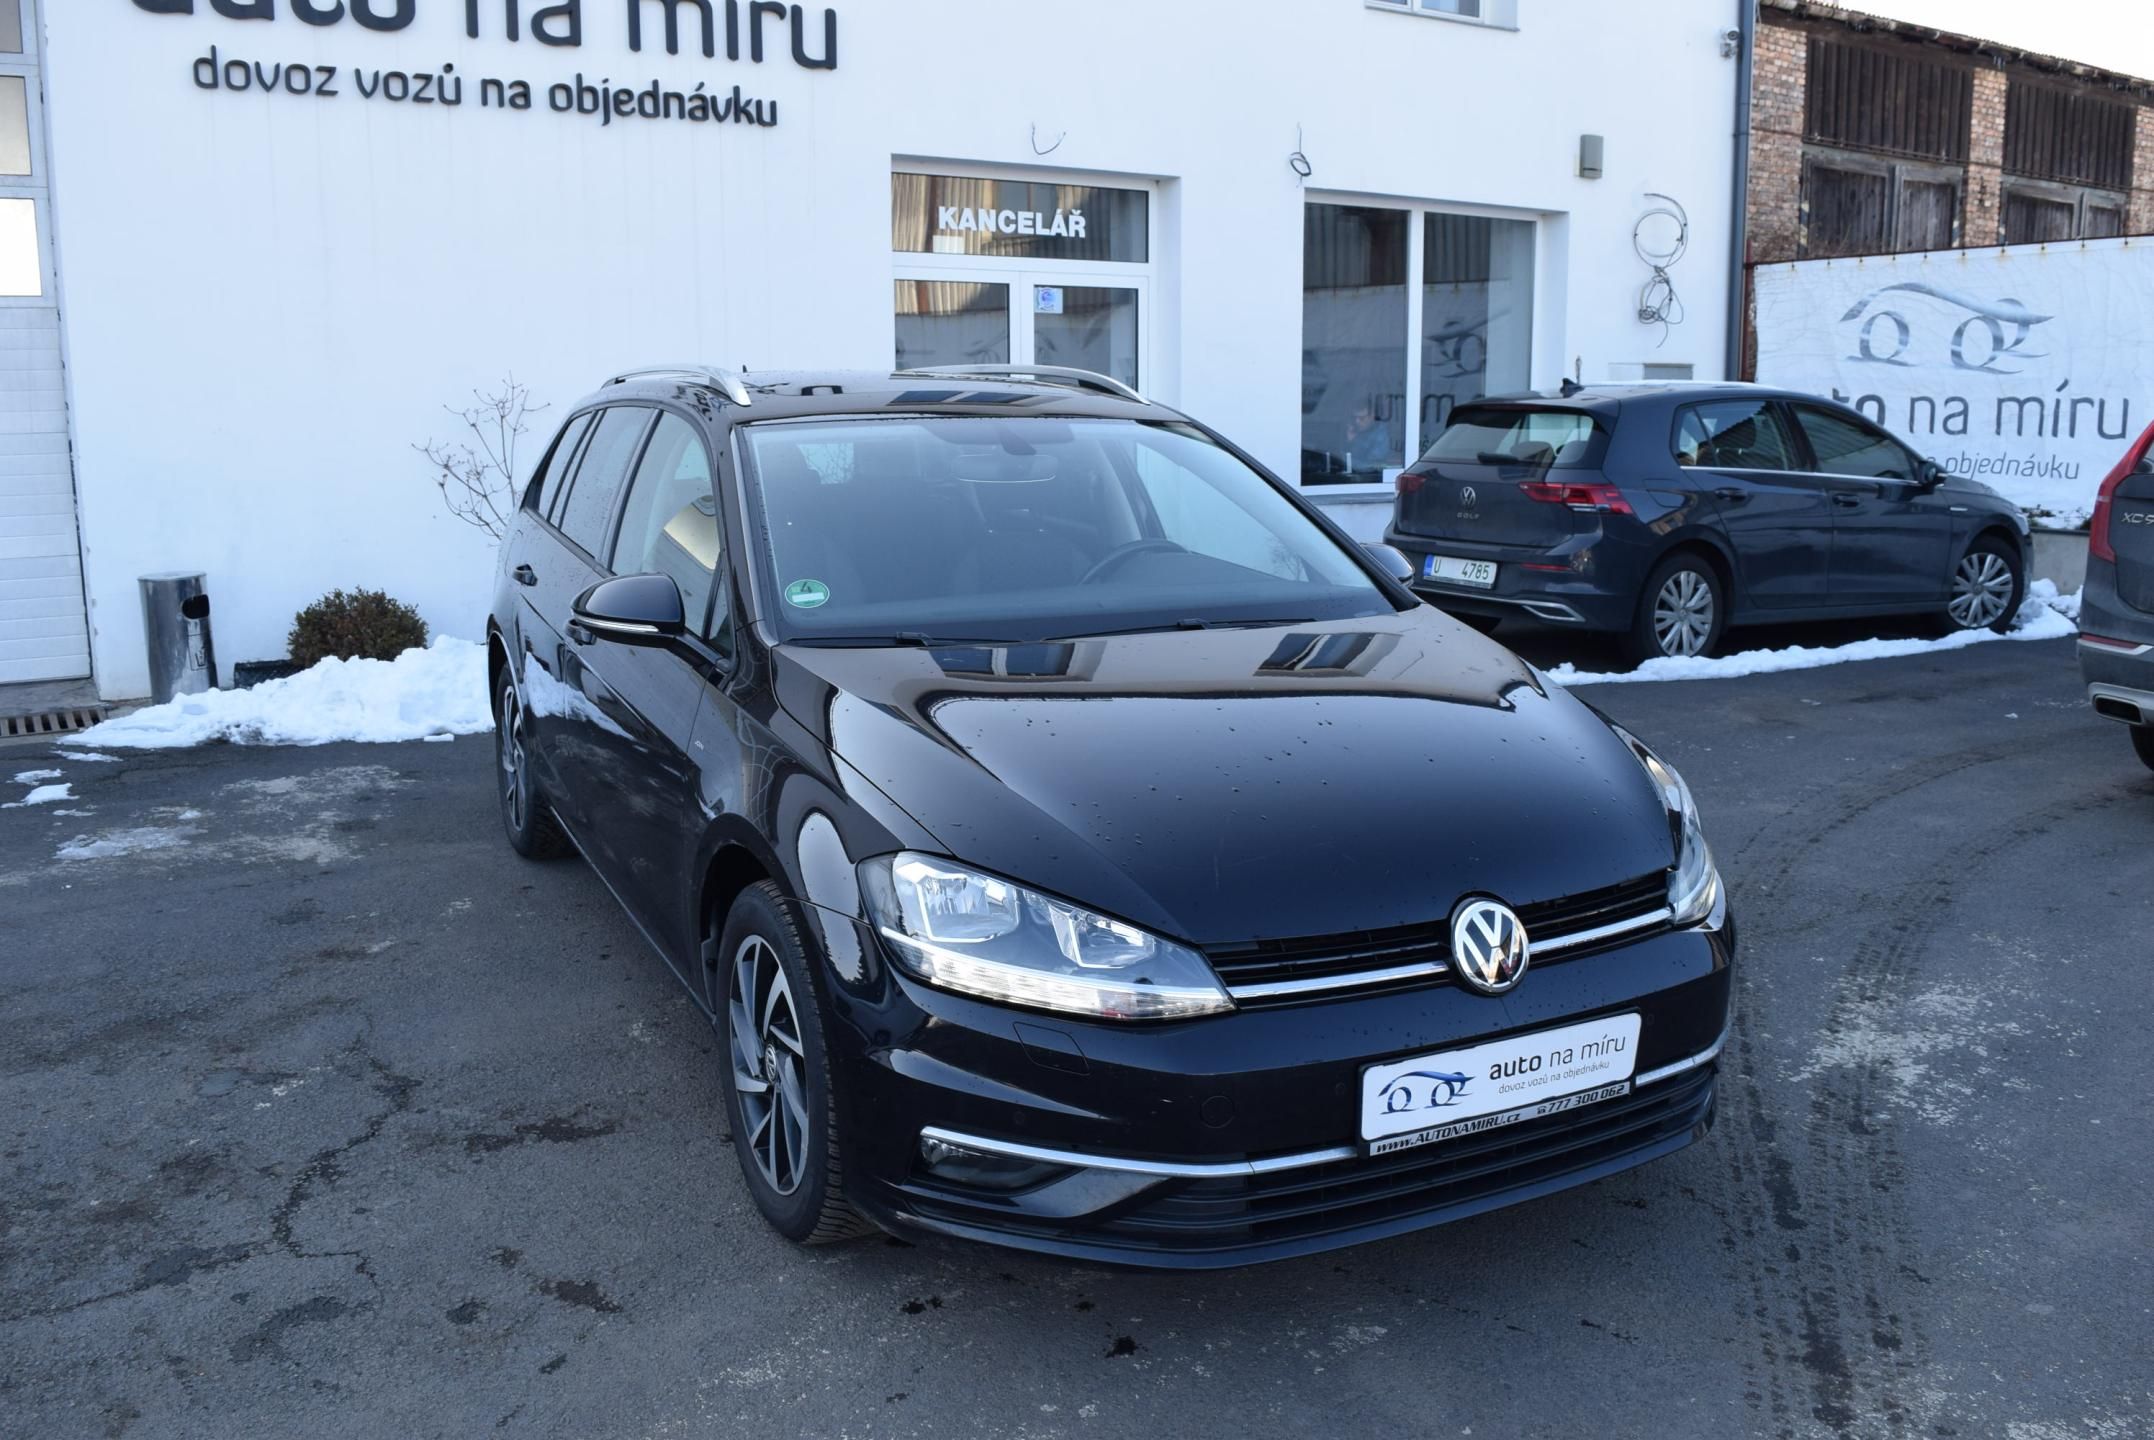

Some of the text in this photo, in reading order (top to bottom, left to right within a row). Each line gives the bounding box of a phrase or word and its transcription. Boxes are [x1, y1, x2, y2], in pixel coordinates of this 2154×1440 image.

[193, 45, 778, 127] dovoz vozů na objednávku
[938, 205, 1087, 238] KANCELÁŘ
[1909, 395, 1970, 435] na
[1995, 378, 2129, 440] míru
[1946, 450, 2080, 481] objednávku
[2121, 512, 2154, 525] XC9
[1461, 562, 1490, 580] 4785
[1489, 1034, 1626, 1081] auto na míru
[1498, 1060, 1610, 1095] dovoz vozů na objednávku
[1548, 1084, 1626, 1112] 777 300 062
